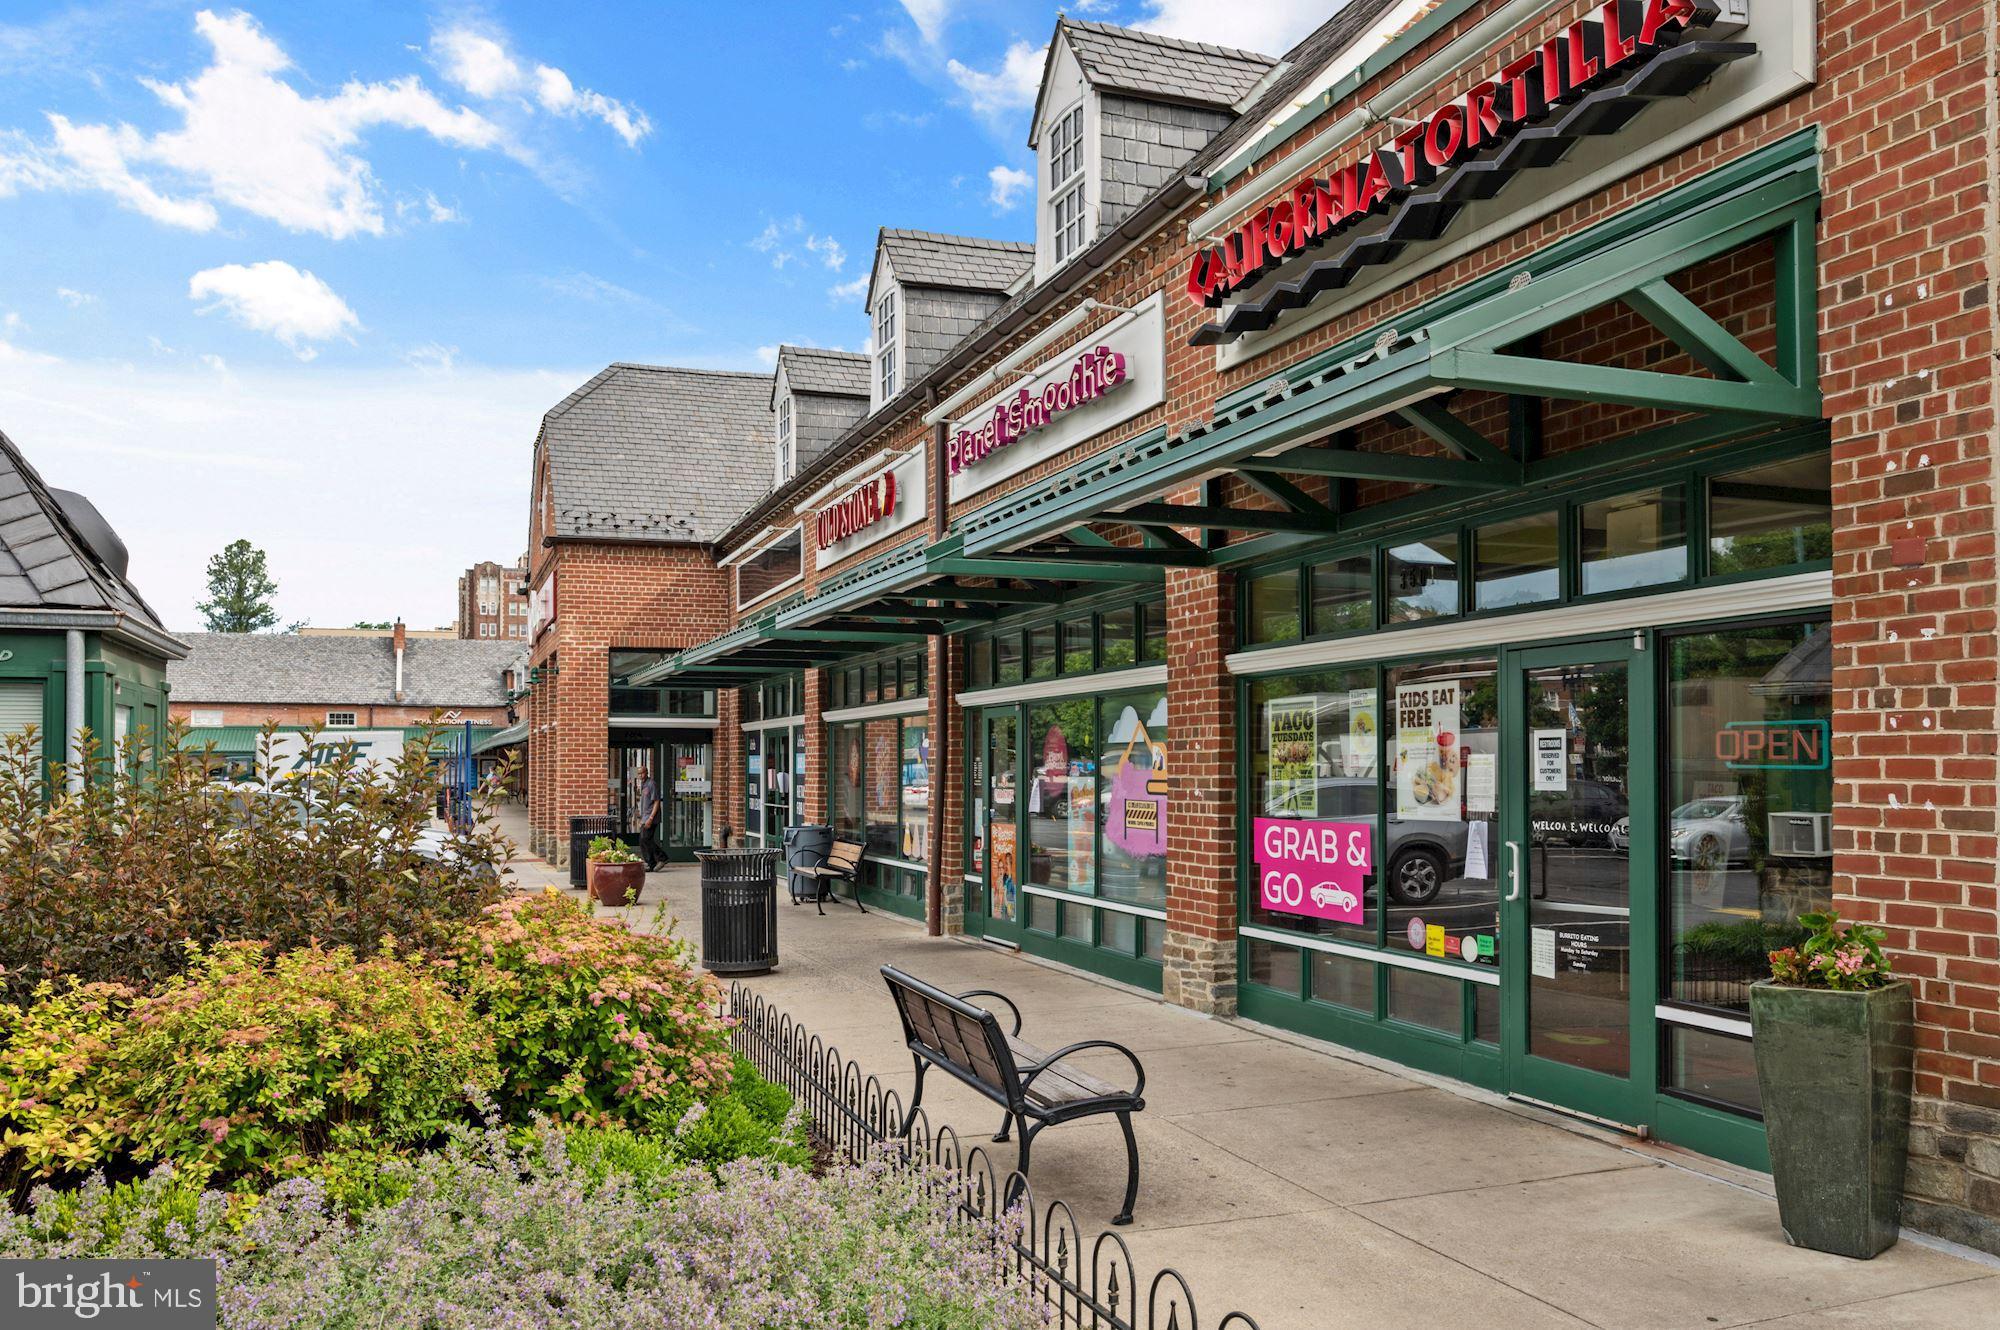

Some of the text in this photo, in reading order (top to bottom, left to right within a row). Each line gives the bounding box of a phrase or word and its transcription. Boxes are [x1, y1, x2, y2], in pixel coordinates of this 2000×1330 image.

[1187, 0, 1703, 308] CALIFORNIA TORTILLA
[946, 346, 1124, 475] Planet Smoothie
[841, 480, 876, 537] STONE
[1400, 688, 1455, 708] KIDS EAT
[1272, 710, 1314, 731] TACO
[1400, 708, 1432, 728] FREE
[1272, 731, 1314, 742] TUESDAYS
[1715, 729, 1818, 760] OPEN
[1579, 822, 1626, 834] WELCOME
[1264, 825, 1368, 867] GRAB &
[1264, 870, 1303, 906] GO
[1559, 932, 1599, 942] BURRITO EATING
[1581, 949, 1598, 957] Saturday
[1572, 961, 1587, 969] Sunday
